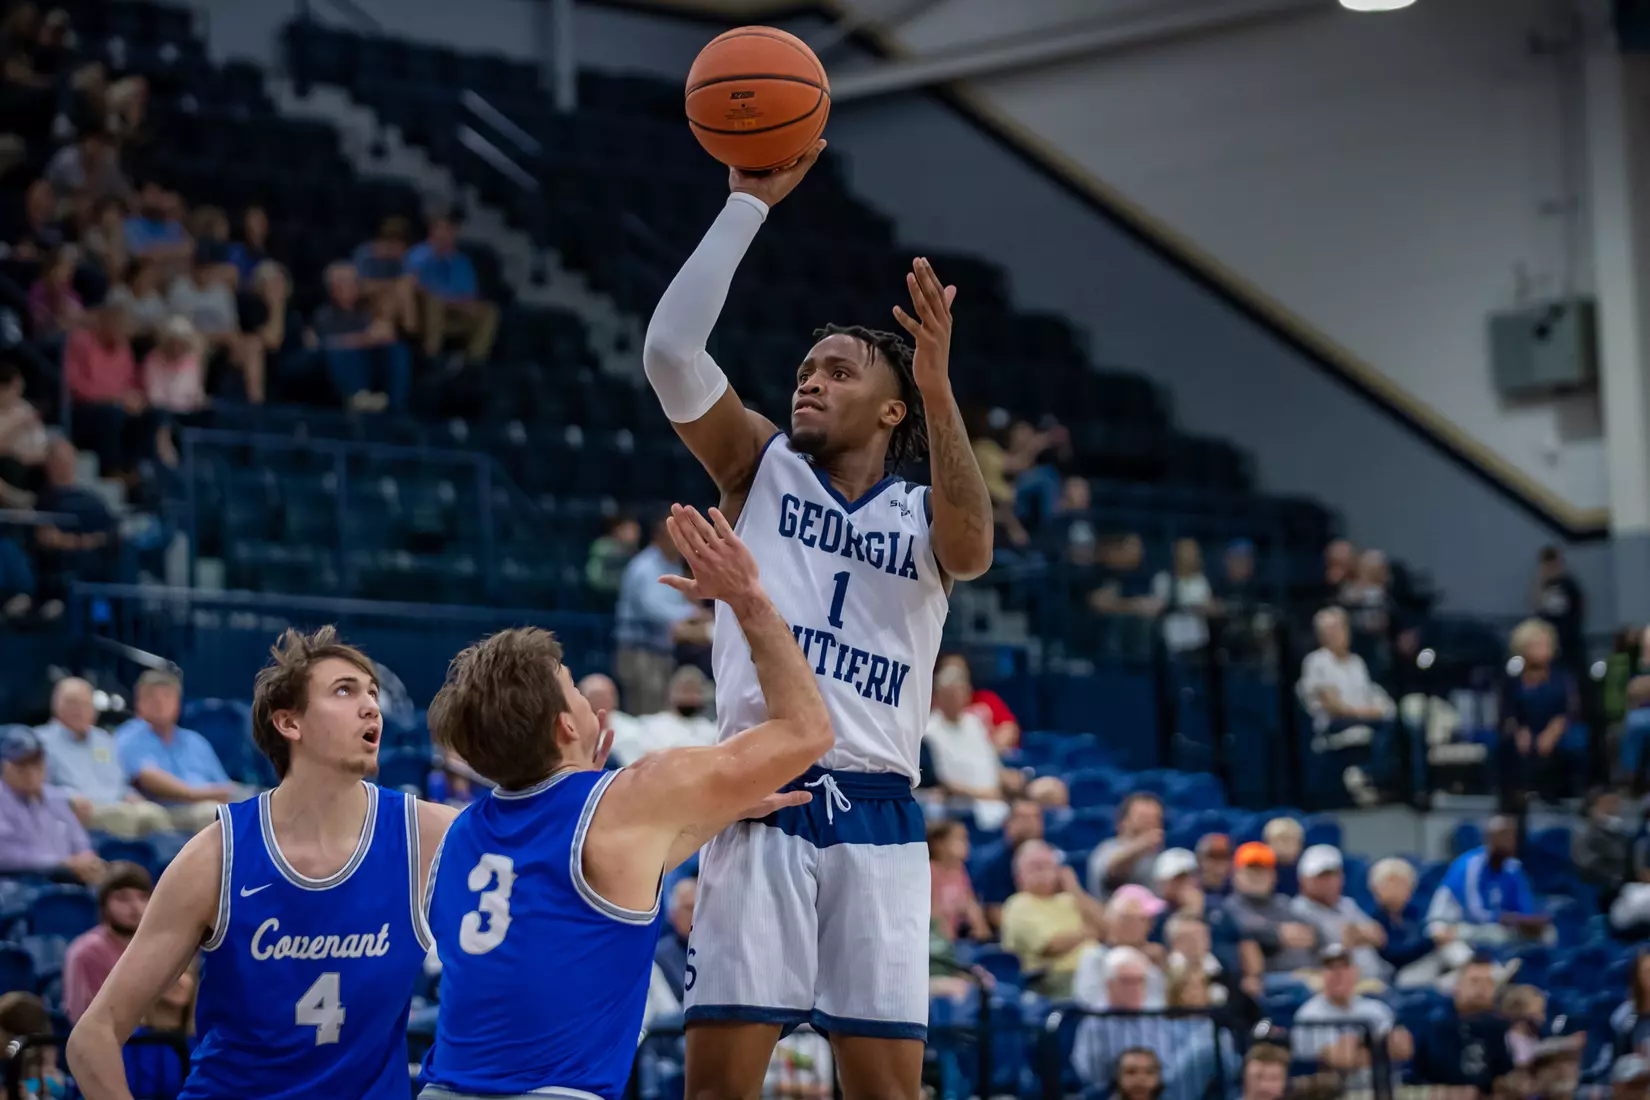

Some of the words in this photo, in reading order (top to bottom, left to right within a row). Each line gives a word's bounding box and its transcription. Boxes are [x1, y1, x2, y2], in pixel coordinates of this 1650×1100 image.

[778, 493, 918, 580] GEORGIA
[827, 570, 850, 629] 1
[787, 625, 911, 707] UTERN
[251, 917, 390, 961] Covenant
[460, 853, 518, 955] 3
[295, 971, 346, 1046] 4
